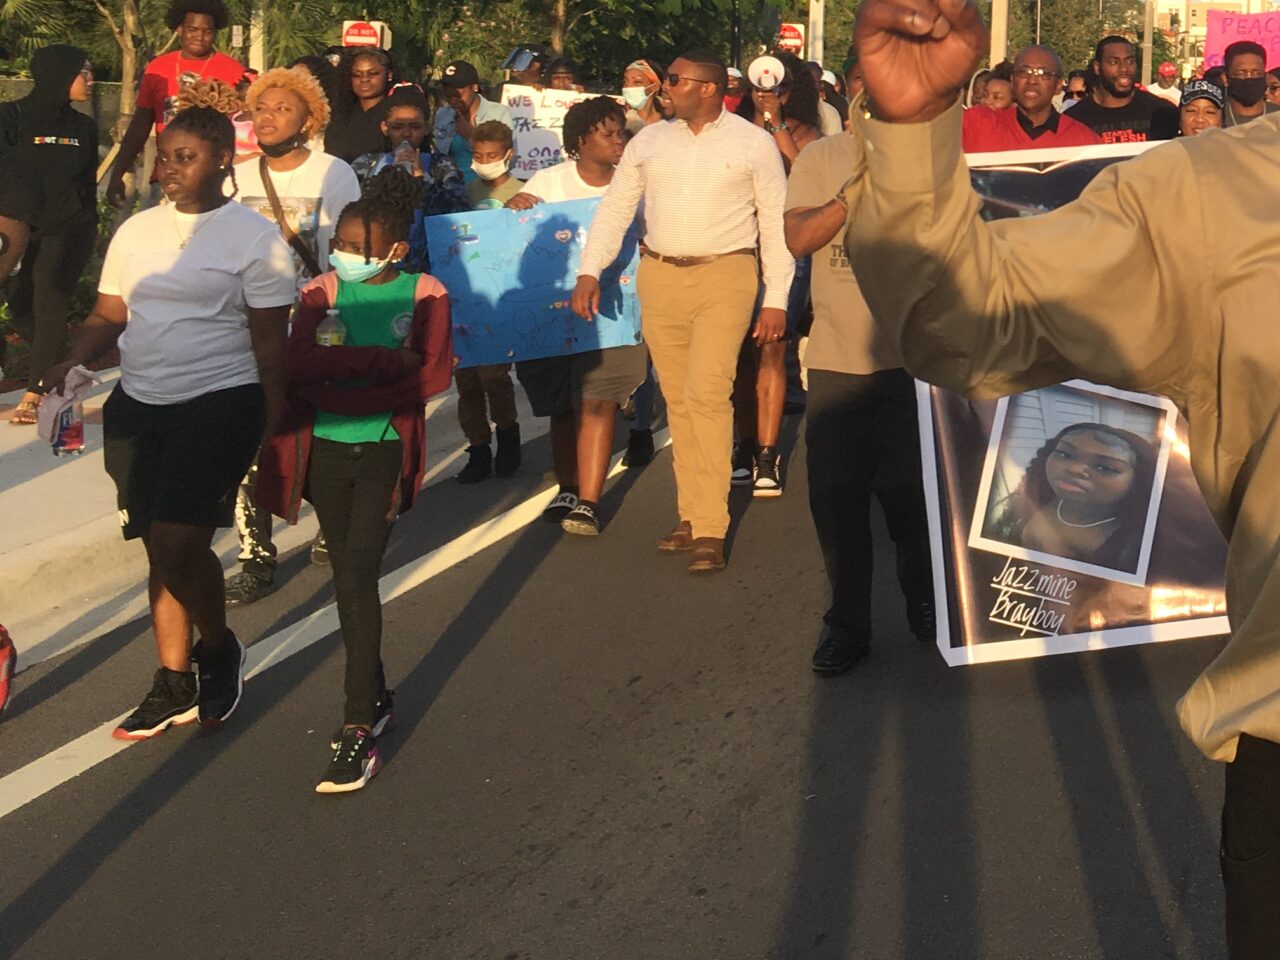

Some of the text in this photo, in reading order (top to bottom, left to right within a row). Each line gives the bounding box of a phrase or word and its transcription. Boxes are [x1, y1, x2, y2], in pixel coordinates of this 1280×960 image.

[445, 65, 457, 76] C
[1184, 80, 1222, 99] BLESSED
[507, 95, 532, 108] WE
[992, 556, 1078, 600] Jazzmine
[989, 589, 1066, 637] Brayboy
